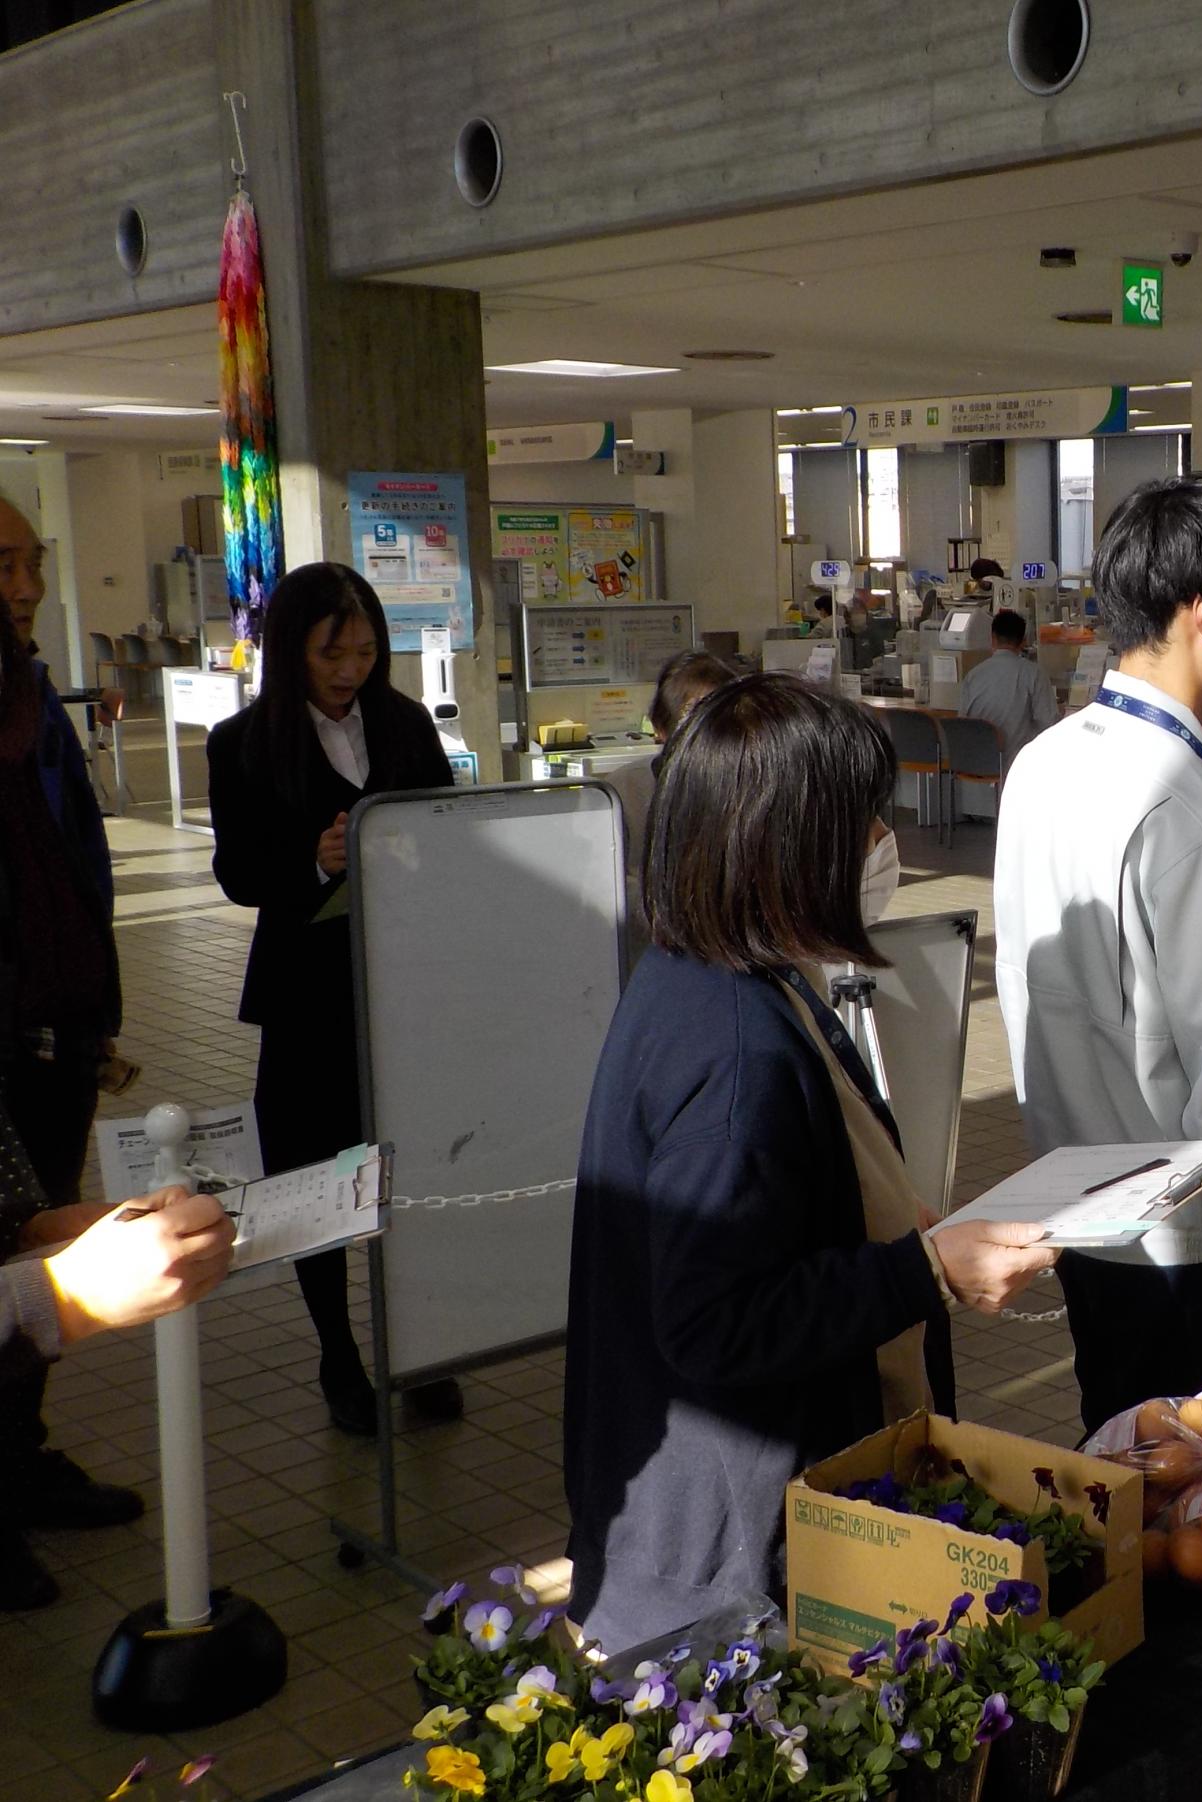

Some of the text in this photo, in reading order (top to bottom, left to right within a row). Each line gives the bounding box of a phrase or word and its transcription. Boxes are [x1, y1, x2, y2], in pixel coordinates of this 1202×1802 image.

[841, 405, 860, 448] 2
[868, 409, 912, 429] 市民課
[1023, 563, 1045, 579] 207
[946, 1542, 1010, 1575] GK204
[960, 1567, 988, 1591] 330
